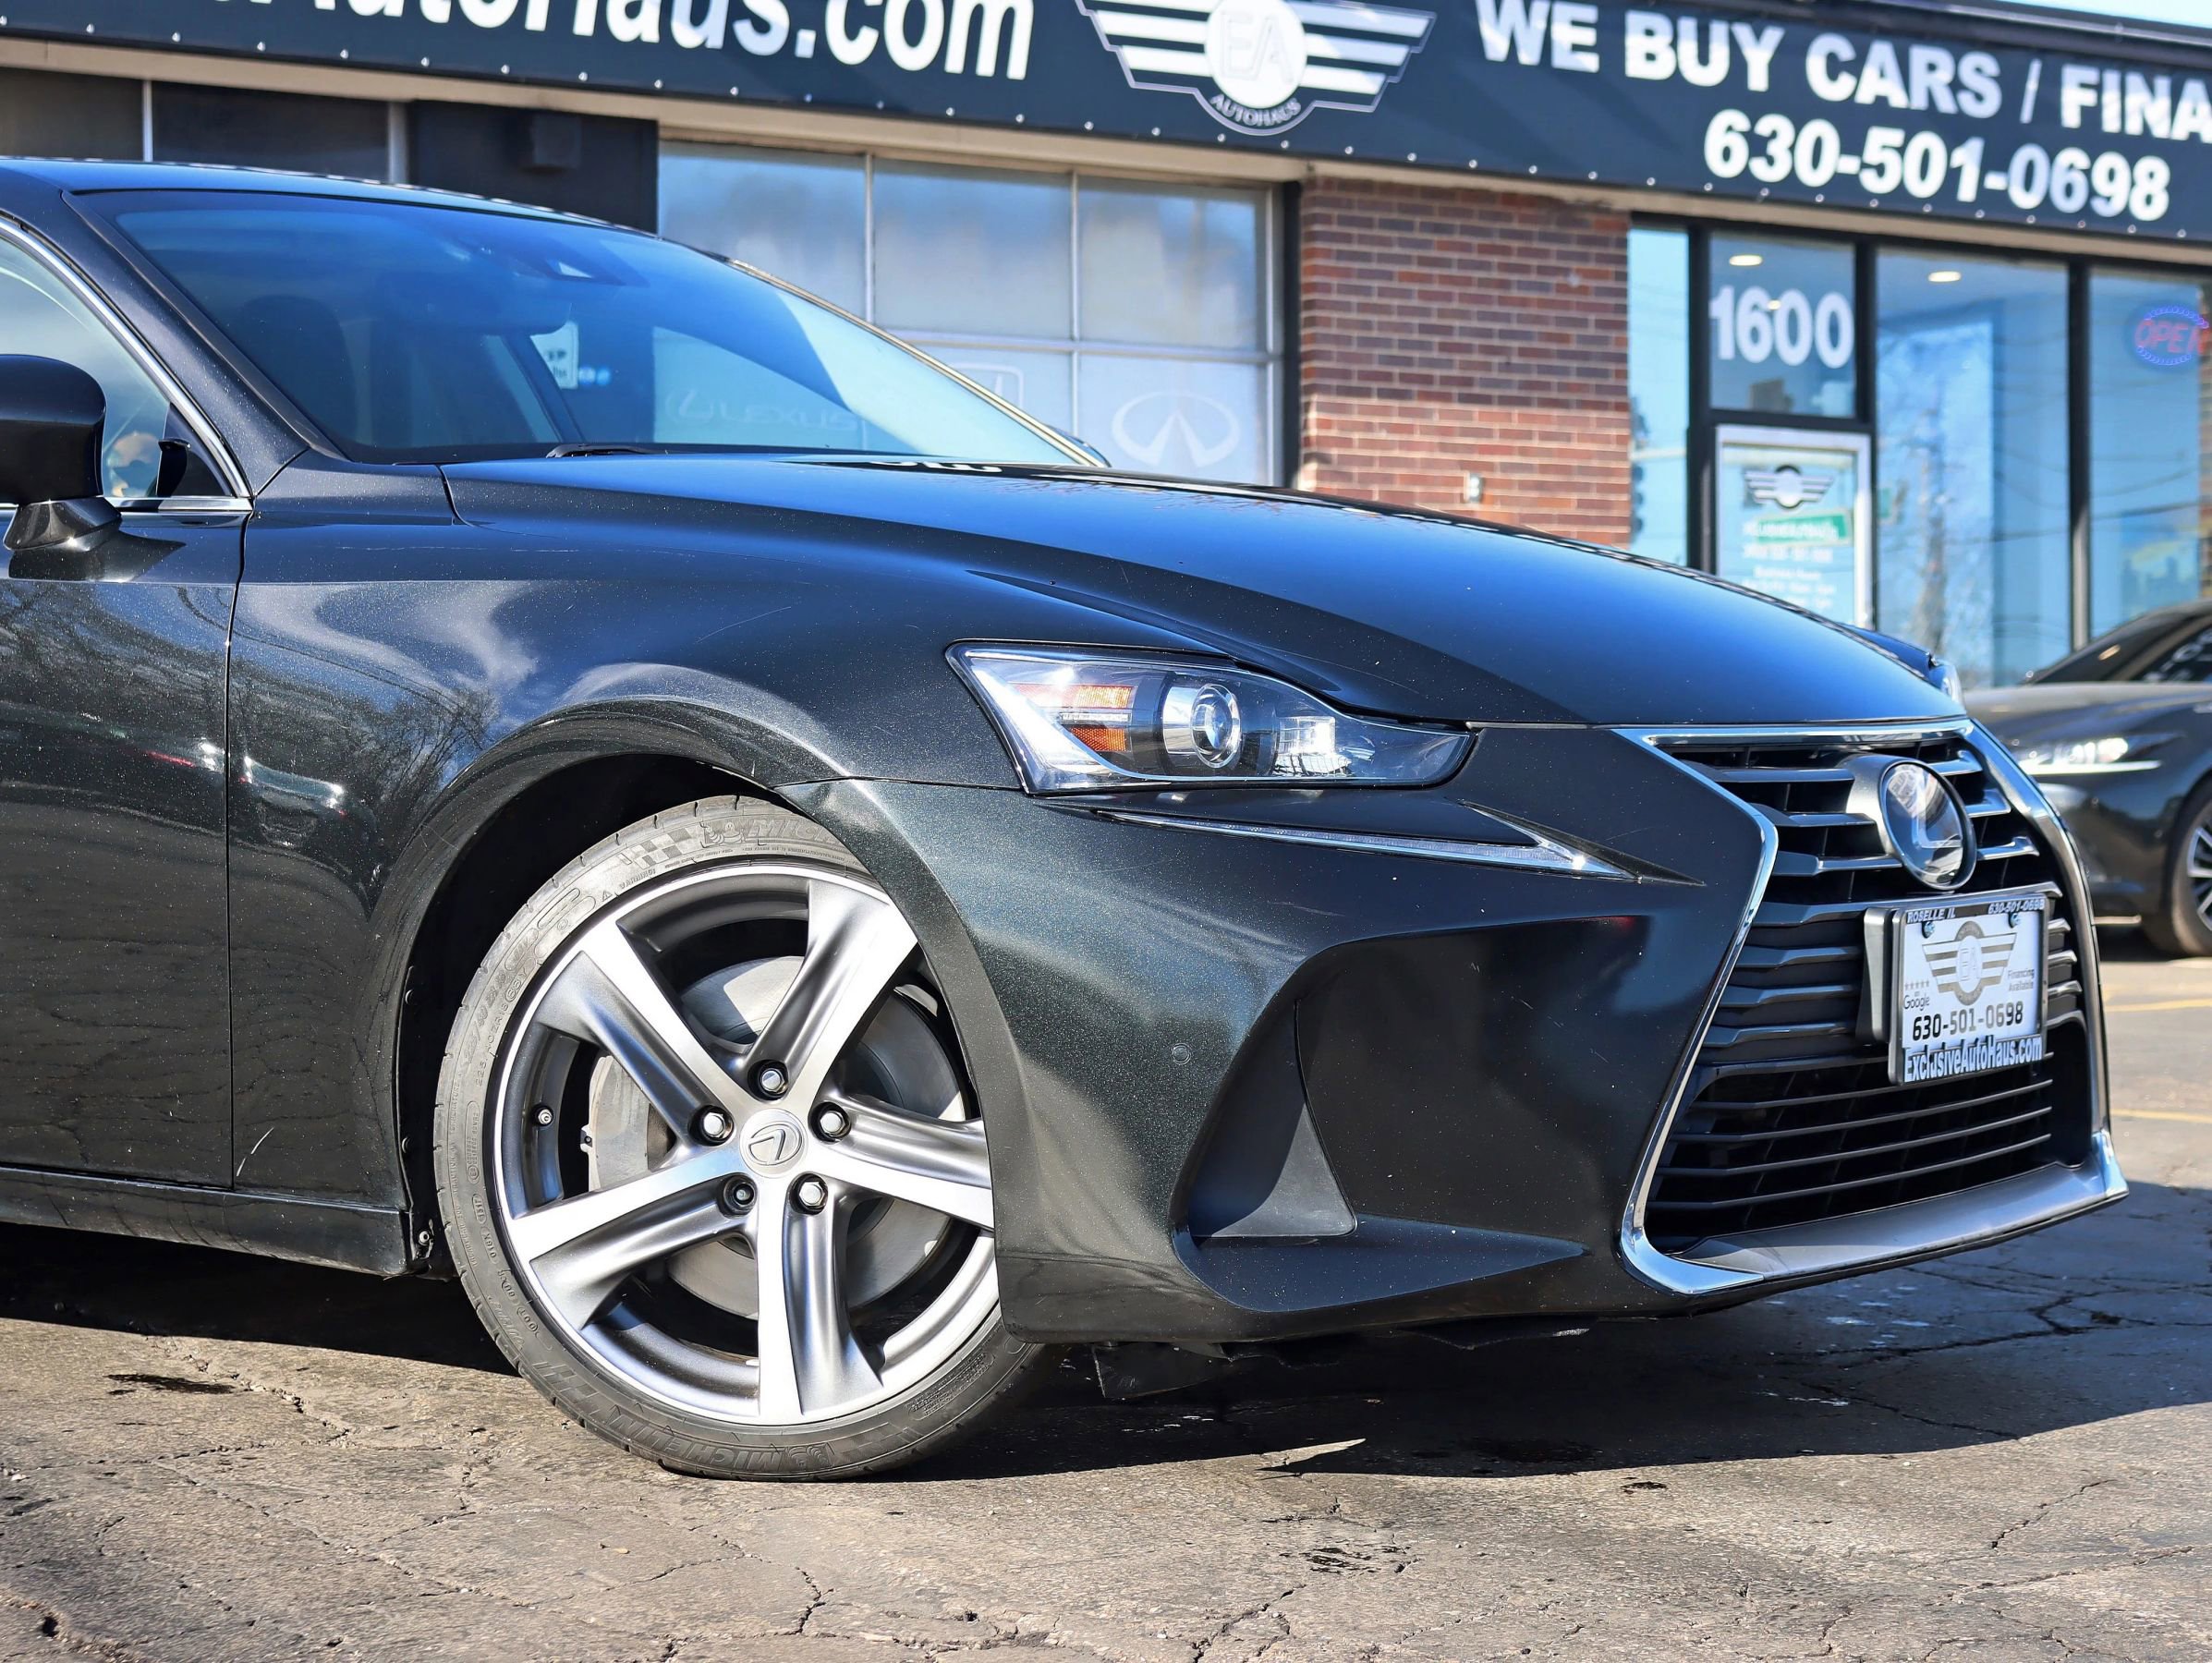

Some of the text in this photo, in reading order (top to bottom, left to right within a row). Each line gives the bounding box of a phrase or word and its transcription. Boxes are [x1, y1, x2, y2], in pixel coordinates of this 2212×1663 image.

[1475, 0, 1600, 74] WE
[1624, 9, 1785, 92] BUY
[1805, 32, 2003, 119] CARS
[2019, 57, 2043, 125] /
[1209, 92, 1302, 127] AUTOHAUS
[1704, 108, 2171, 222] 630-501-0698
[1708, 285, 1855, 369] 1600
[1907, 907, 1956, 924] ROSELLE IL
[1988, 899, 2045, 915] 630-501-0698
[2008, 968, 2035, 980] Financing
[2009, 980, 2034, 992] Available
[1904, 992, 1930, 1012] Google
[1912, 1001, 2024, 1041] 630-501-0698
[1903, 1035, 2043, 1083] ExclusiveAutoHaus.com
[604, 1406, 784, 1472] MICHELIN
